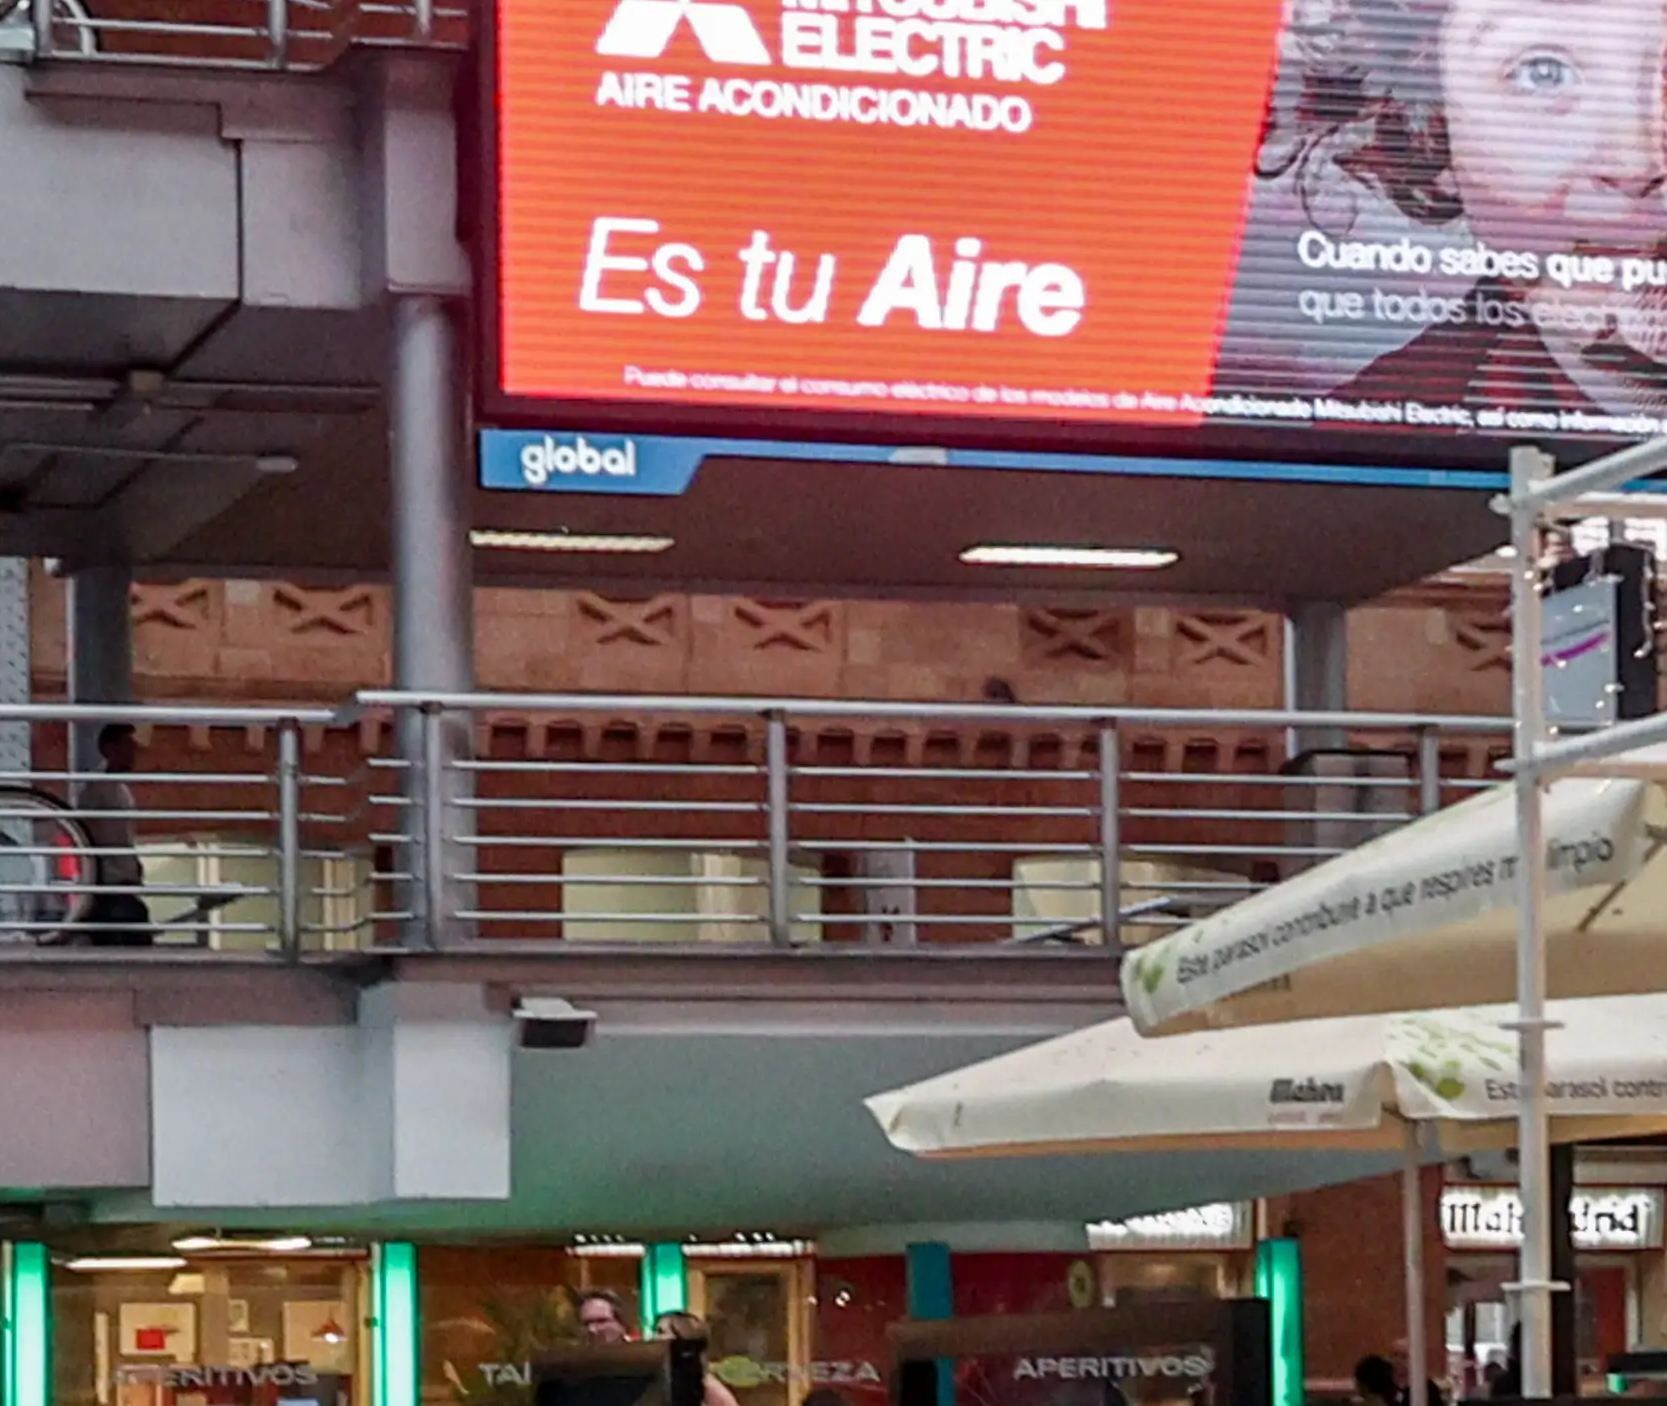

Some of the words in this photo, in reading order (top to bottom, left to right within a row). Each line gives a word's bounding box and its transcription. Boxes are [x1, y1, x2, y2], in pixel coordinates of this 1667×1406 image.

[780, 12, 1066, 84] ELECTRIC
[595, 71, 691, 112] AIRE
[698, 78, 1033, 133] ACONDICIONADO
[579, 217, 704, 317] Es
[739, 230, 835, 323] tu
[856, 233, 1085, 336] Aire
[1297, 230, 1432, 275] Cuando
[1439, 242, 1539, 280] sabes
[1546, 253, 1614, 289] que
[1297, 289, 1365, 325] que
[1371, 289, 1466, 324] todos
[1475, 294, 1524, 327] los
[520, 436, 637, 484] global
[1543, 1075, 1608, 1099] arasol
[1014, 1355, 1209, 1381] APERITIVOS
